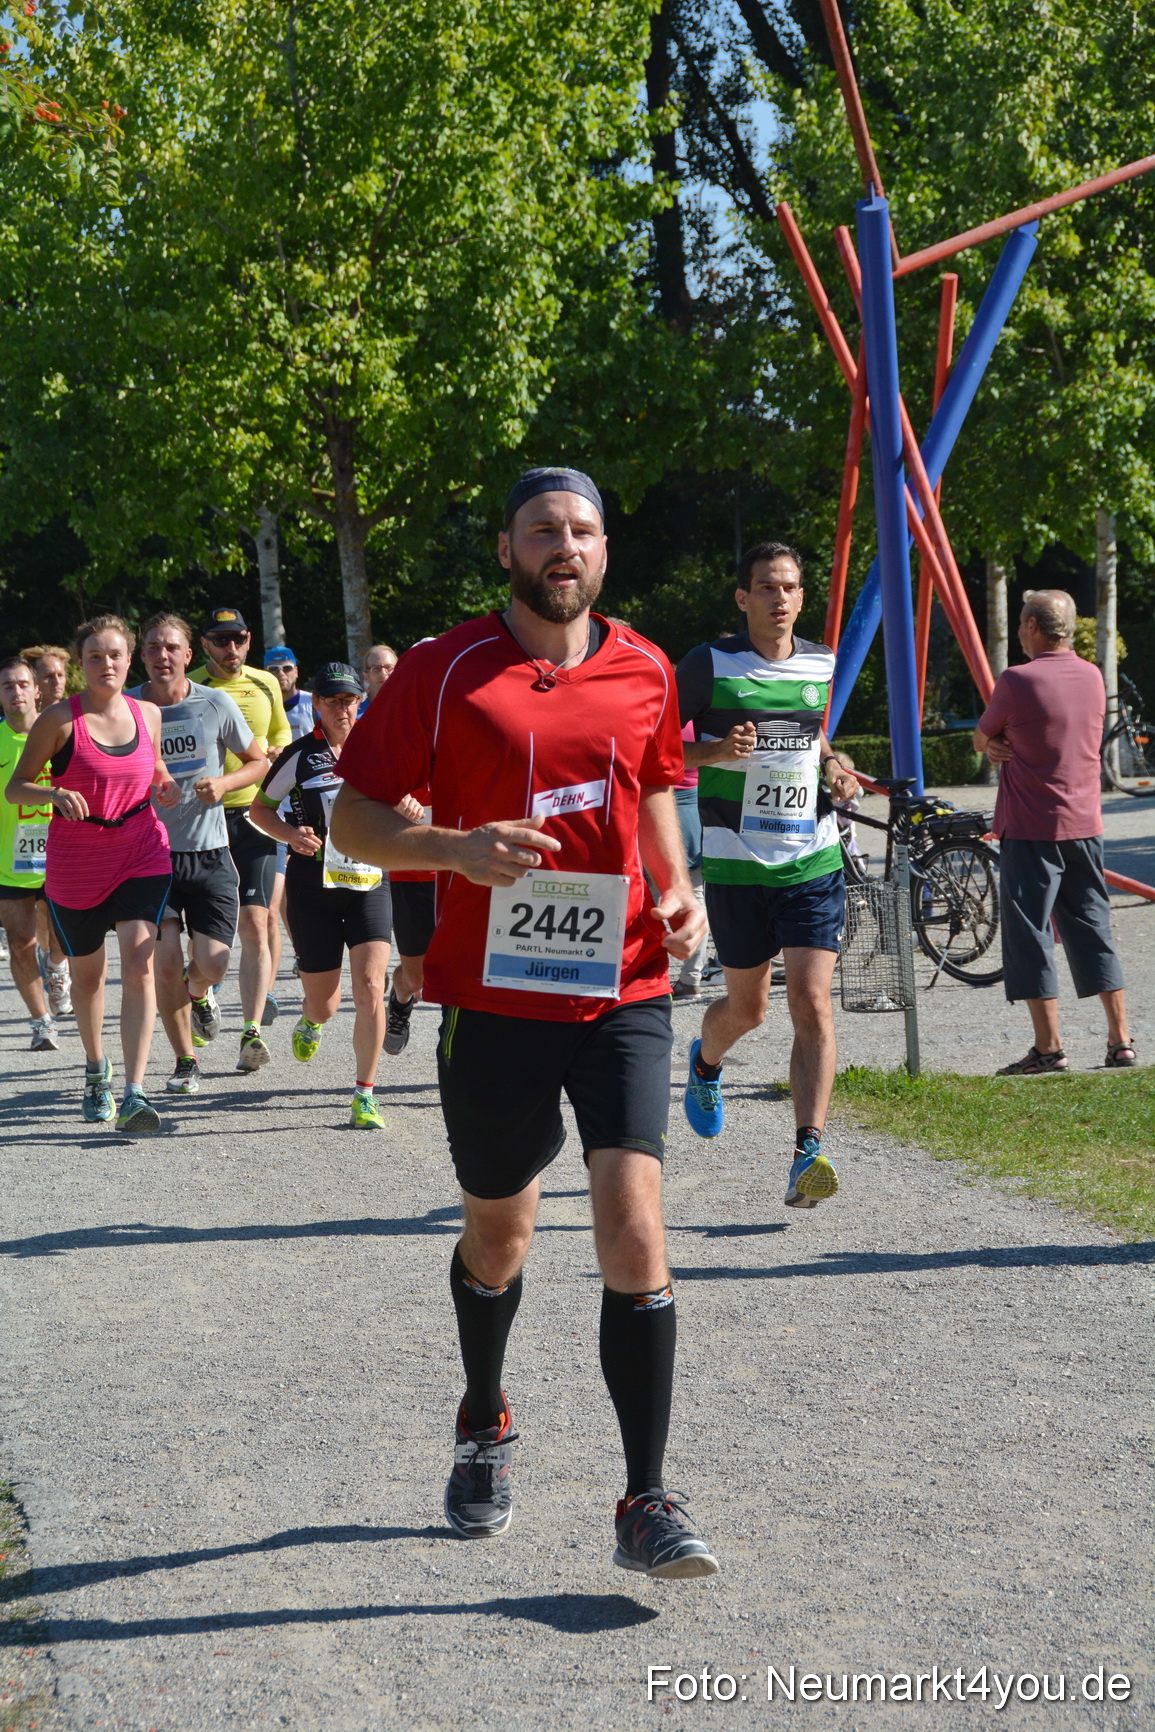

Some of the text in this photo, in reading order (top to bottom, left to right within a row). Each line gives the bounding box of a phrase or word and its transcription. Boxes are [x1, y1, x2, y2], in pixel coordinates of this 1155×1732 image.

[769, 770, 802, 780] BOCK
[552, 791, 585, 808] DEHN
[755, 784, 808, 809] 2120
[760, 819, 800, 833] Wolfgang
[338, 873, 369, 884] Christina
[532, 880, 590, 896] BOCK
[508, 902, 605, 944] 2442
[516, 944, 583, 956] PARTL Neumarkt
[525, 961, 580, 981] Jürgen
